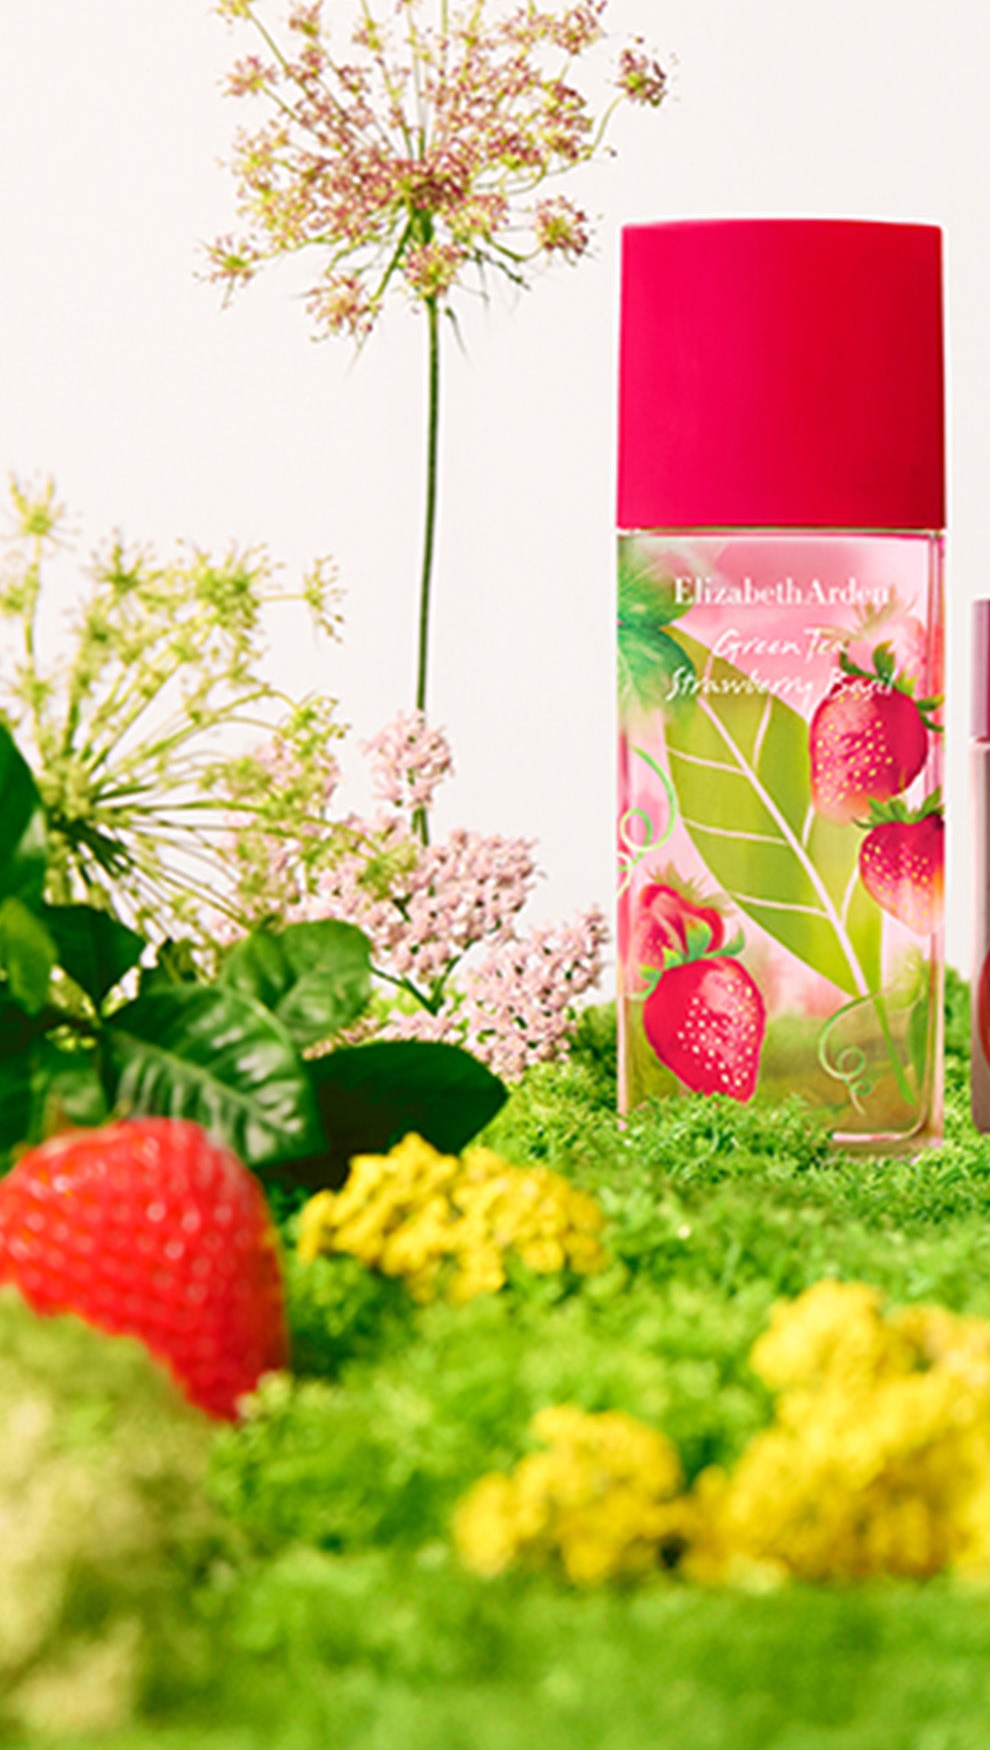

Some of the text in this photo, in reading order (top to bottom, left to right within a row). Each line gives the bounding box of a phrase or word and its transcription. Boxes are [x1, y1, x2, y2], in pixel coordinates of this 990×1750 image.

[711, 627, 848, 663] Green Tea
[666, 666, 899, 706] Strawberry Basil
